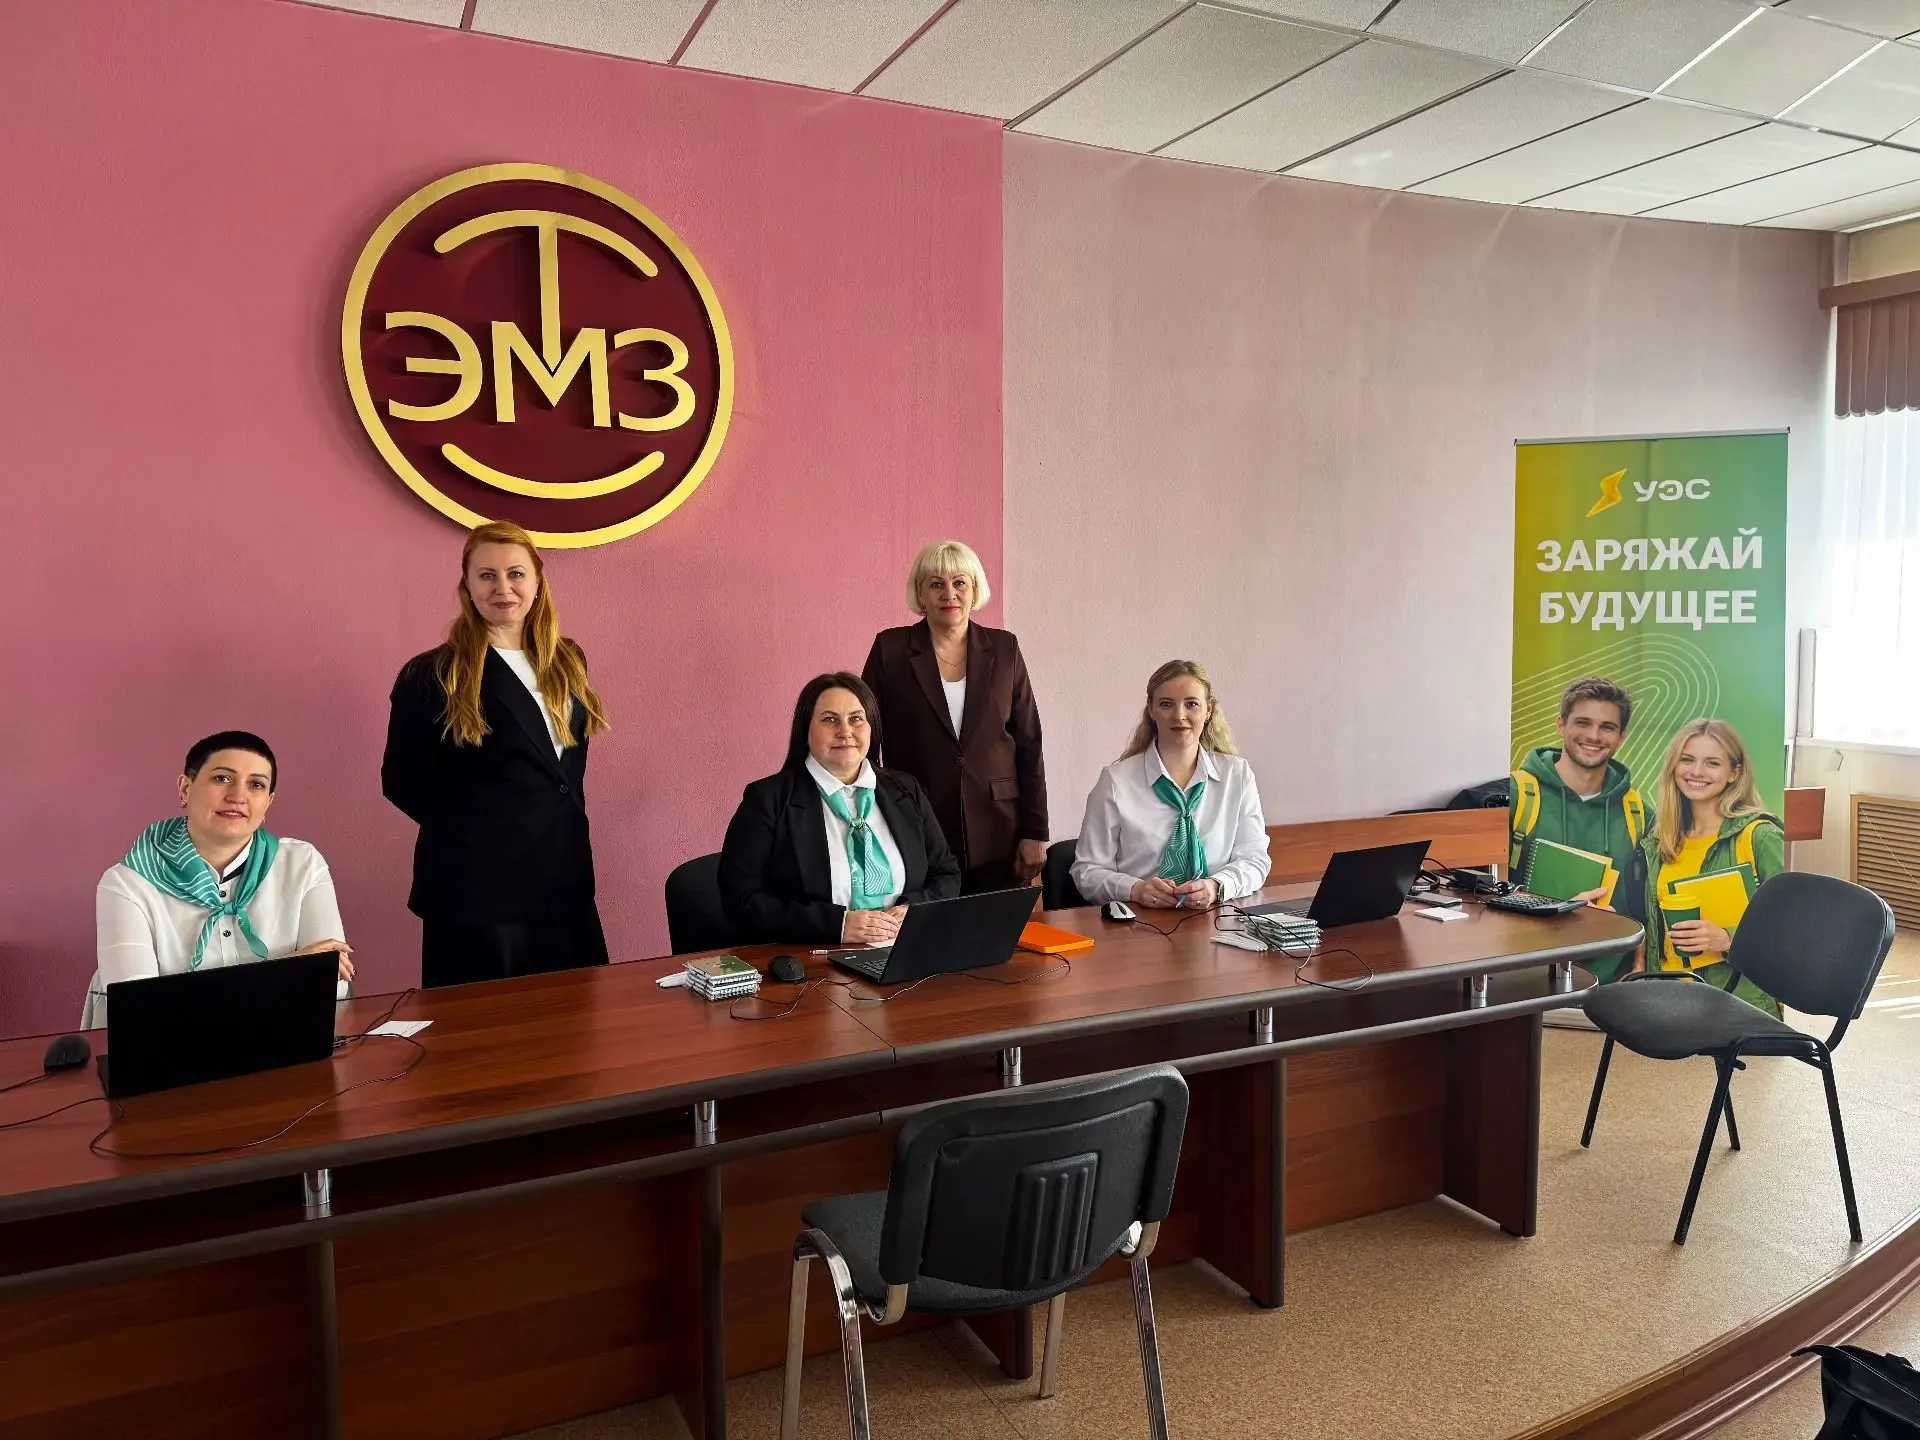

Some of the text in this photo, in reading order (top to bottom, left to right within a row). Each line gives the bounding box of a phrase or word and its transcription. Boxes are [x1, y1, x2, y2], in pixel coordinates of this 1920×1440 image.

[1633, 478, 1711, 502] УЭС
[1536, 527, 1763, 573] ЗАРЯЖАЙ
[1539, 590, 1757, 632] БУДУЩЕЕ
